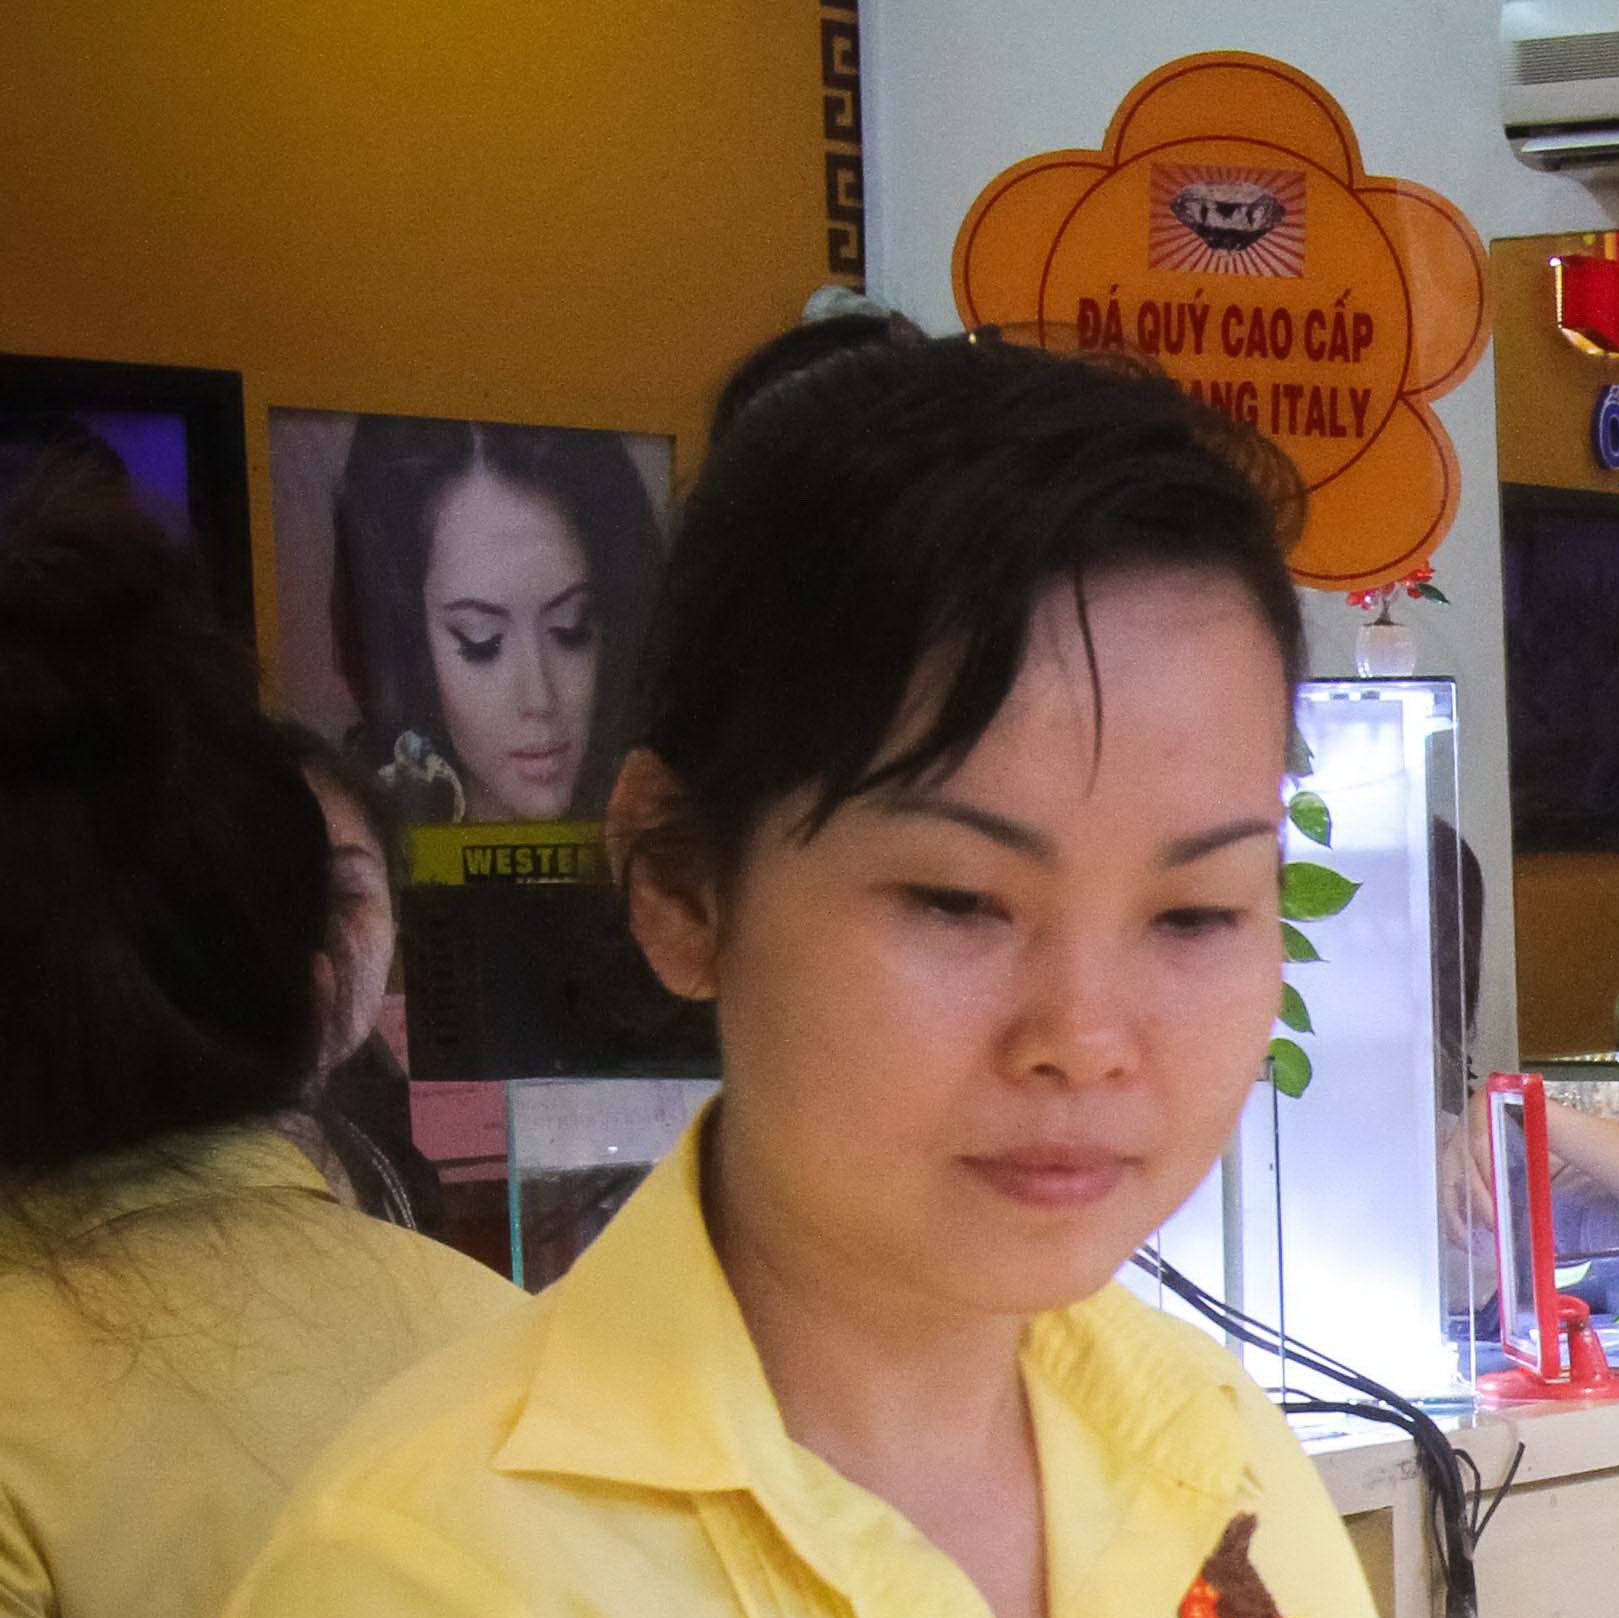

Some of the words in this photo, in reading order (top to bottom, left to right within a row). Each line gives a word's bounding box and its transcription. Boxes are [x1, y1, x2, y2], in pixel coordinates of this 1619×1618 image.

[1137, 288, 1210, 356] QUÝ
[1221, 304, 1293, 360] CAO
[1304, 288, 1375, 364] CẤP
[1271, 382, 1371, 438] ITALY
[463, 847, 580, 875] WESTE
